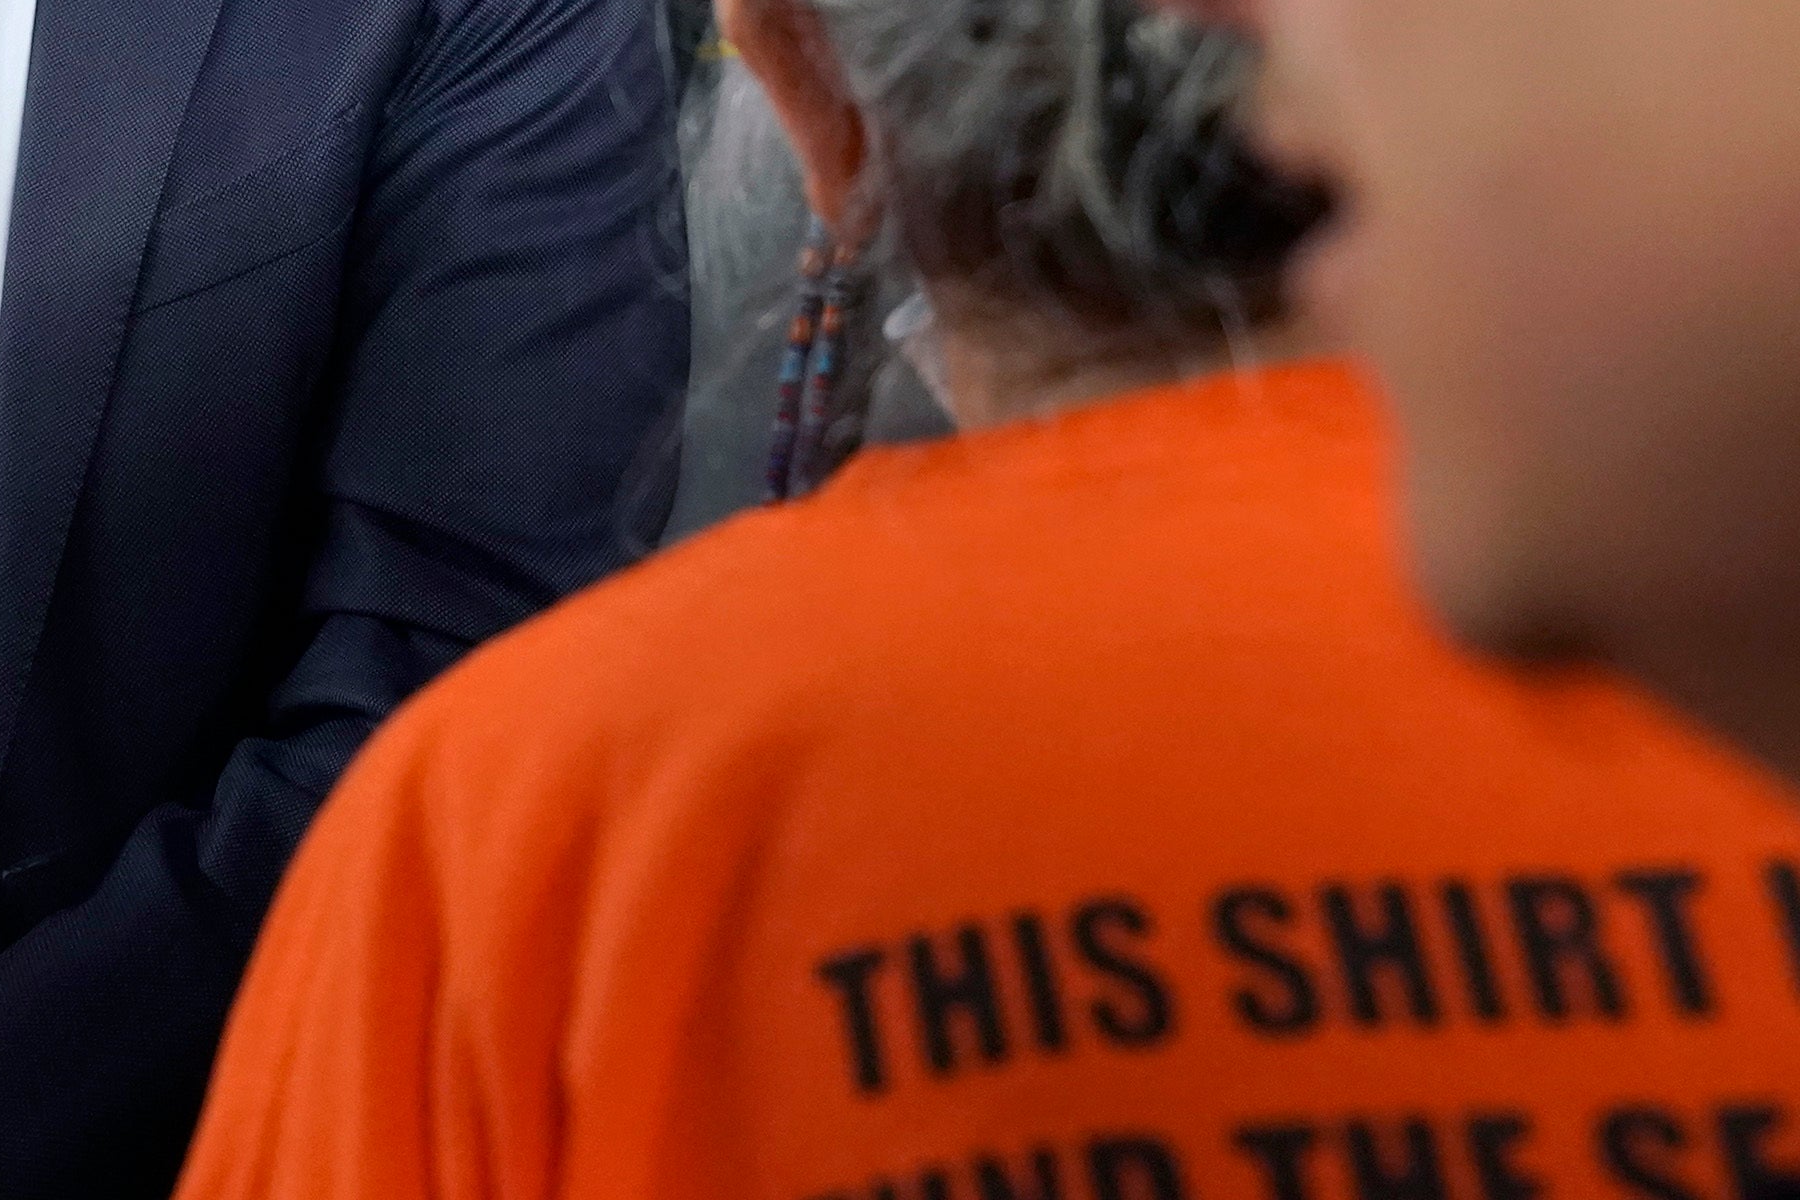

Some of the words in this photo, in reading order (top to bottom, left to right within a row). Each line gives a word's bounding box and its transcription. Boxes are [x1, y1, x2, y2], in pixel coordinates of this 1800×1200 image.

[812, 894, 1176, 1098] THIS
[1210, 862, 1716, 1042] SHIRT
[1228, 1110, 1546, 1200] THE
